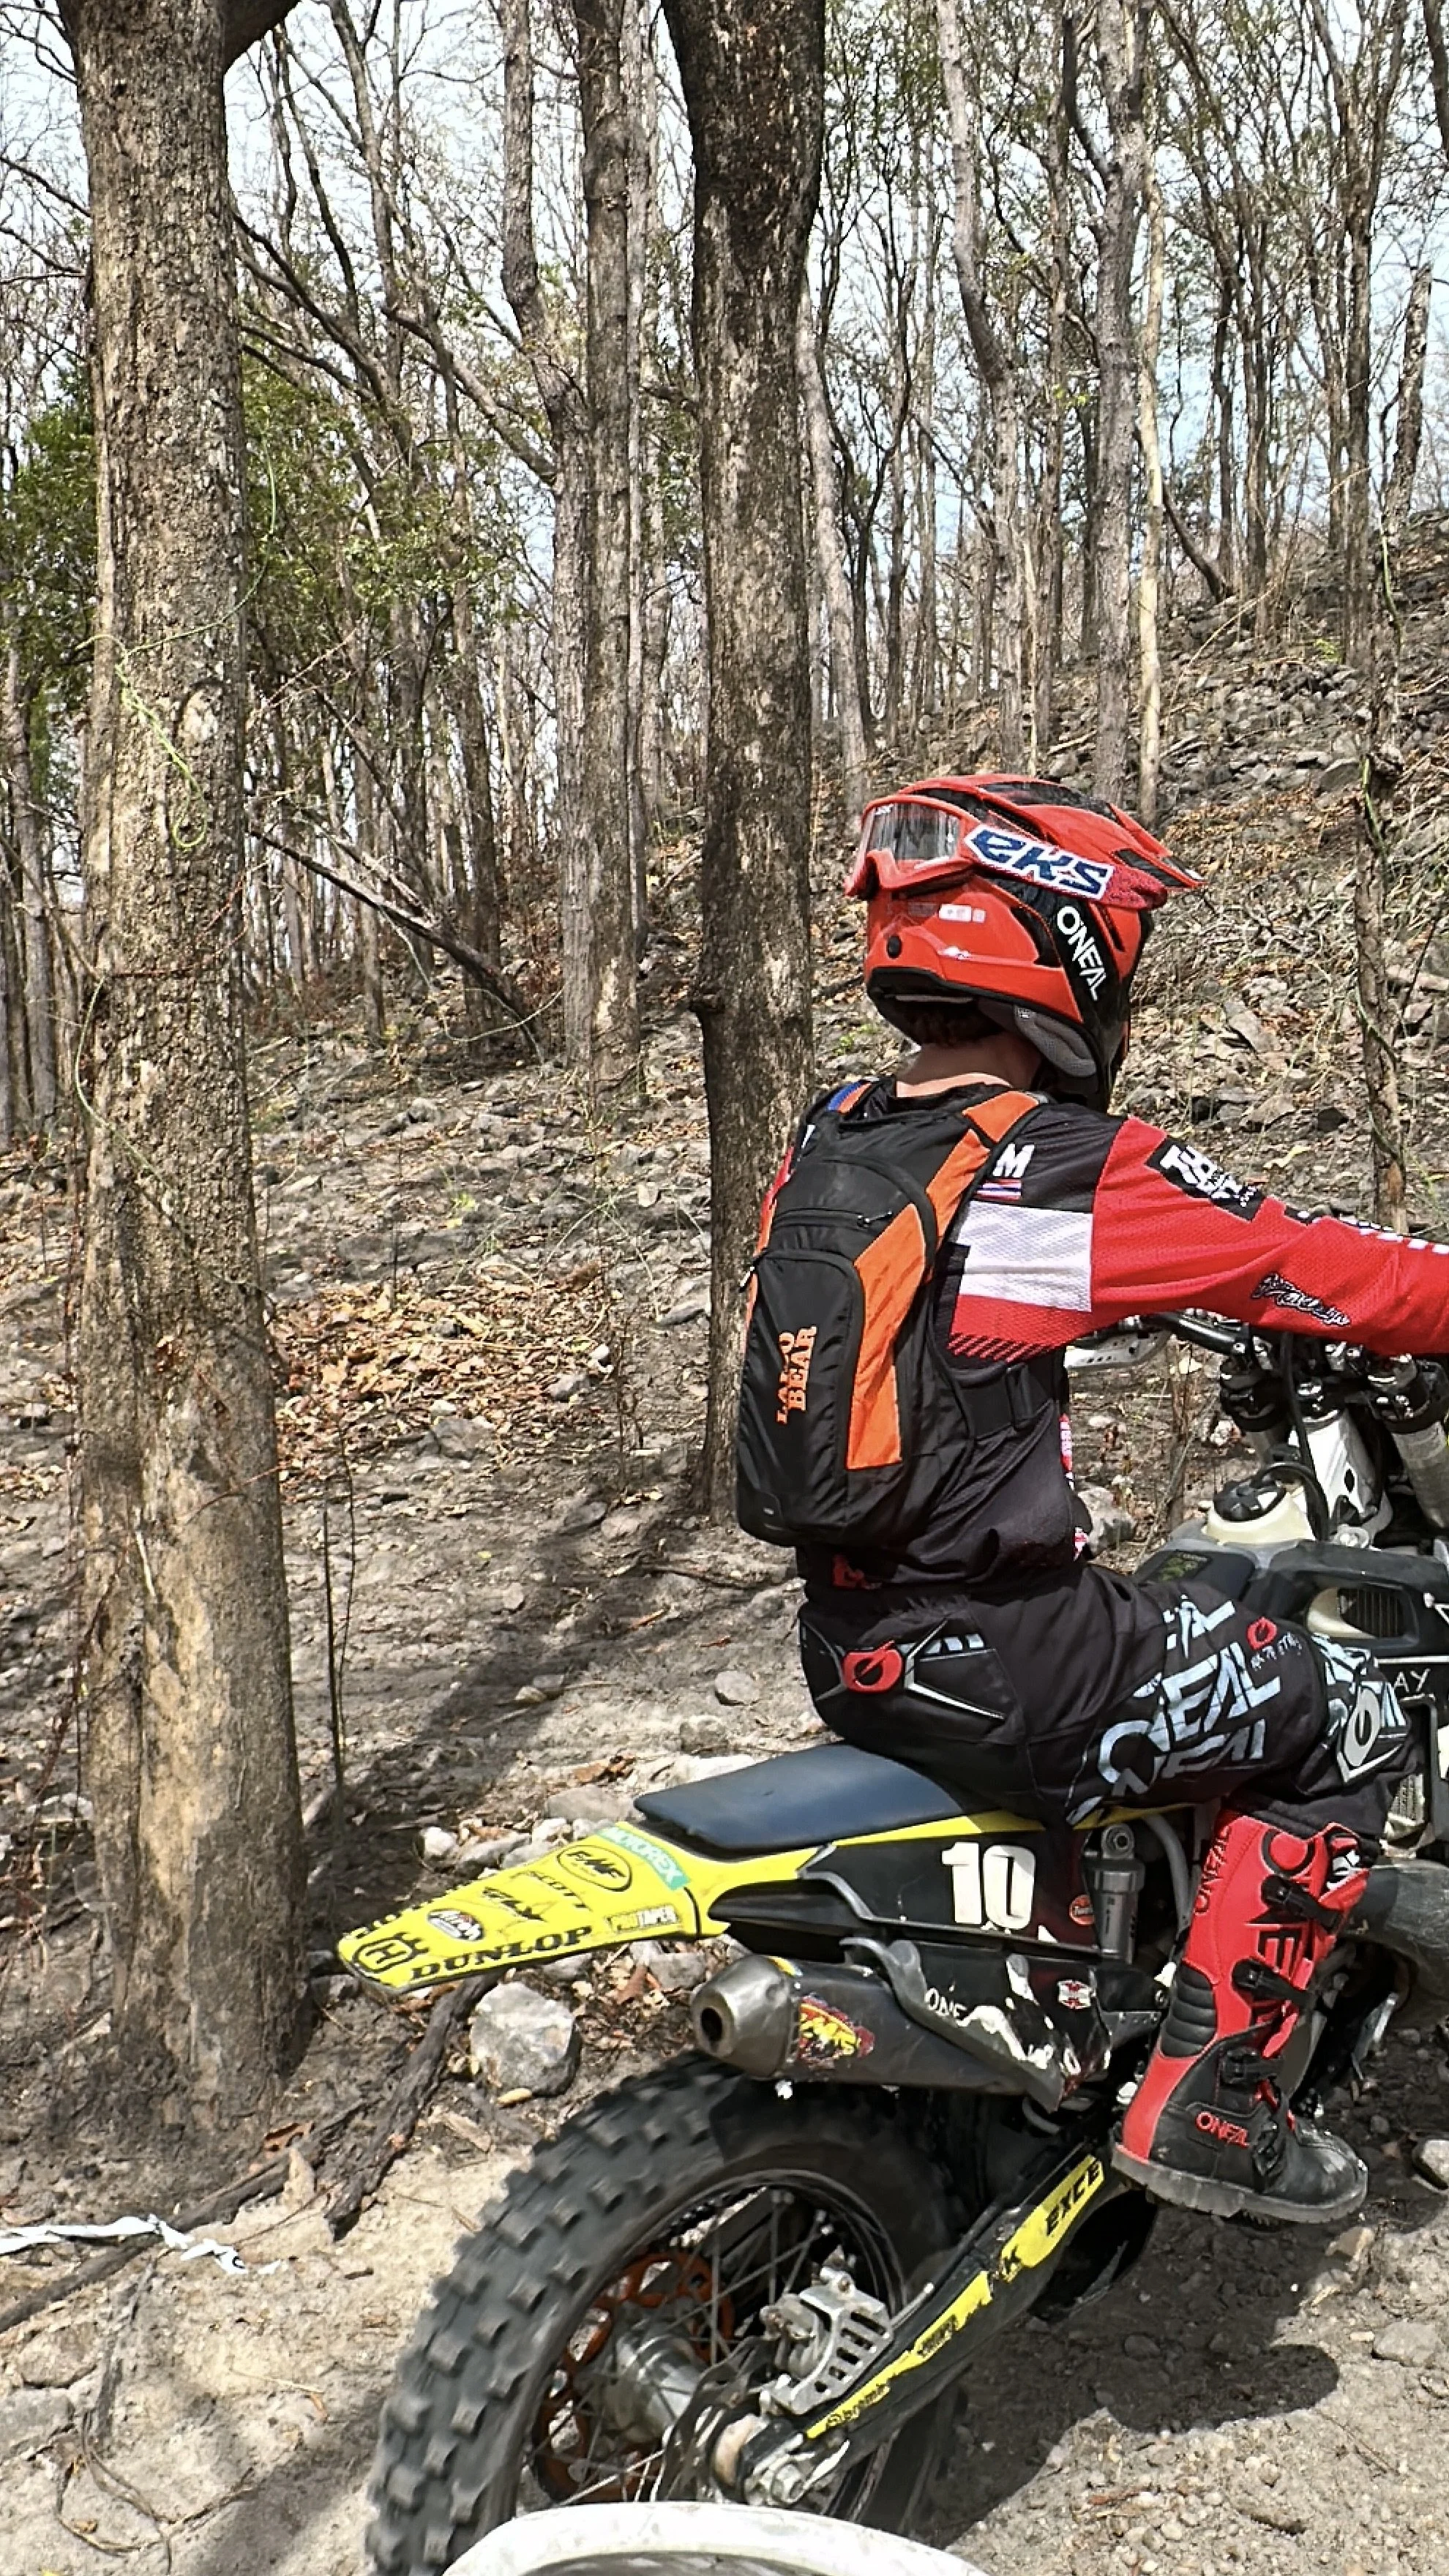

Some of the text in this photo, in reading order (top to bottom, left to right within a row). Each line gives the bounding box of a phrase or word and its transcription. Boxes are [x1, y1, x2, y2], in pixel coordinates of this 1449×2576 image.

[788, 1325, 817, 1411] BEAR
[941, 1841, 1036, 1931] 10
[411, 1925, 593, 1980] DUNLOP
